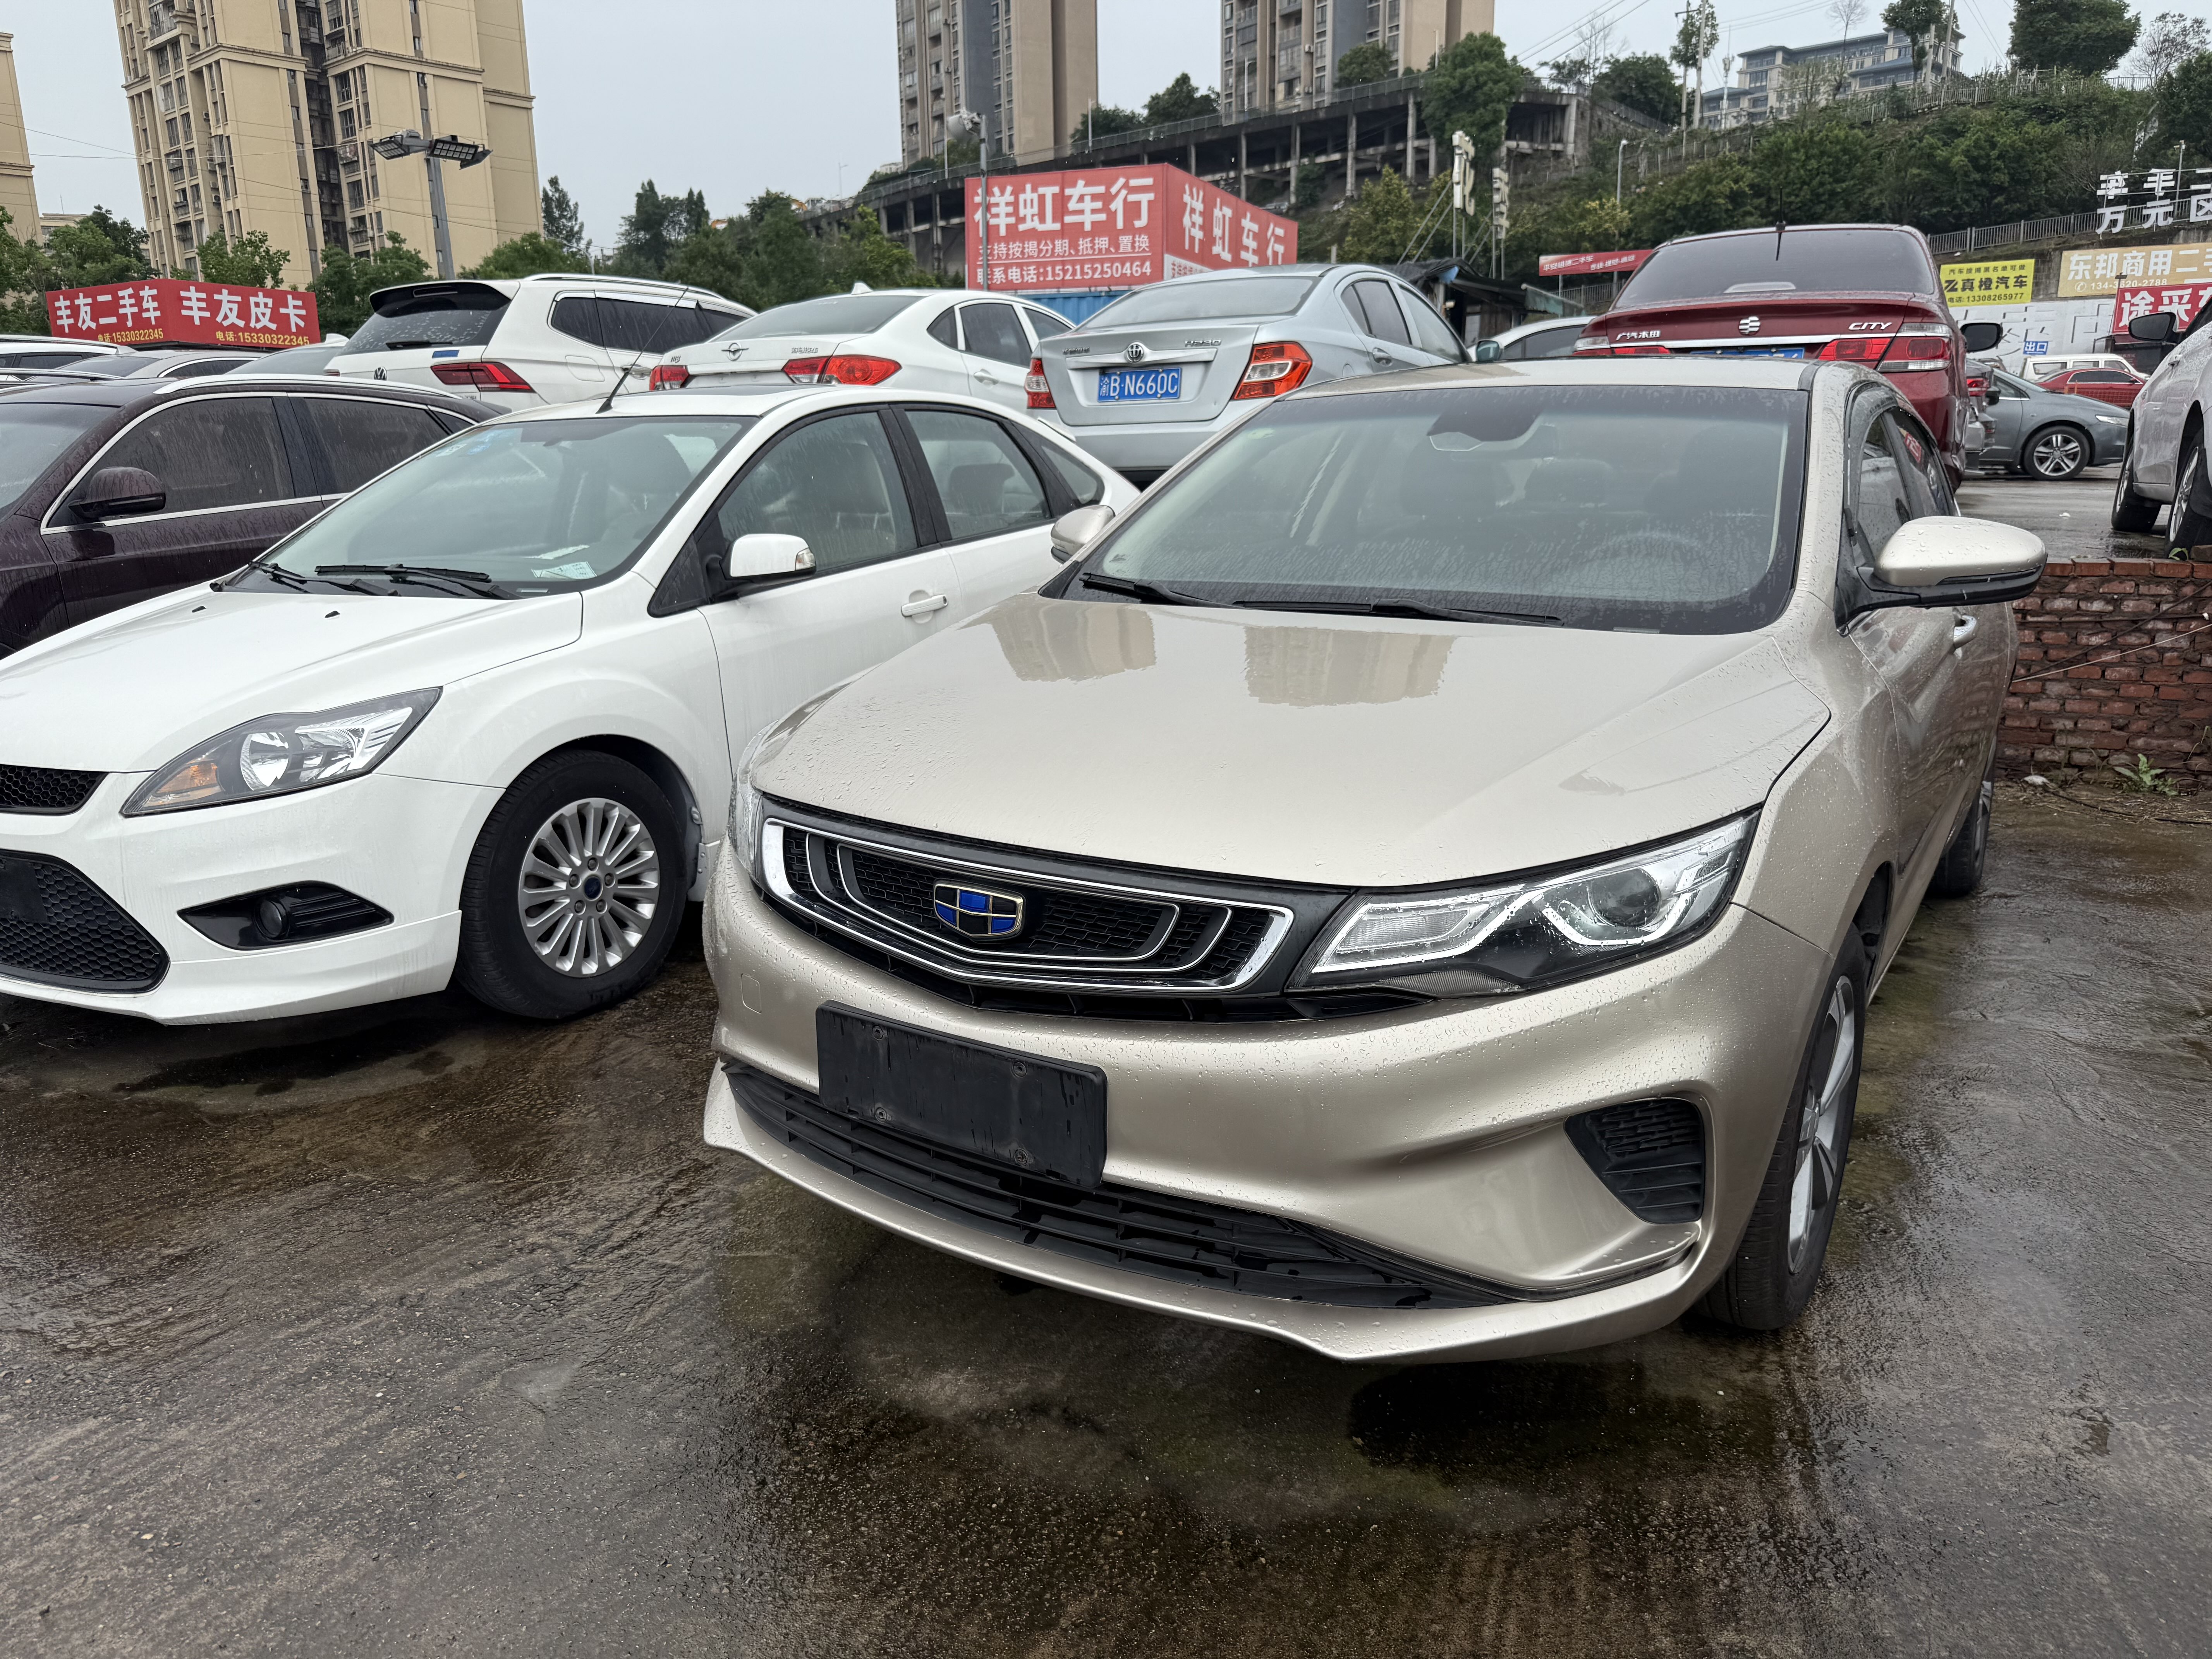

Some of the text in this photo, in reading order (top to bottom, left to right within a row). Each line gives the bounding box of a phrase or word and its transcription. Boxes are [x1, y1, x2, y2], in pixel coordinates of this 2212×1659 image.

[974, 177, 1154, 237] 祥虹车行
[1183, 184, 1284, 267] 祥虹车行
[979, 234, 1149, 260] 支持按揭分期、抵押、置换
[54, 285, 161, 333] 丰友二手车
[180, 286, 306, 332] 丰友皮卡
[1848, 322, 1893, 330] CITY
[1616, 330, 1661, 341] 广汽本田
[2025, 342, 2047, 352] 出口
